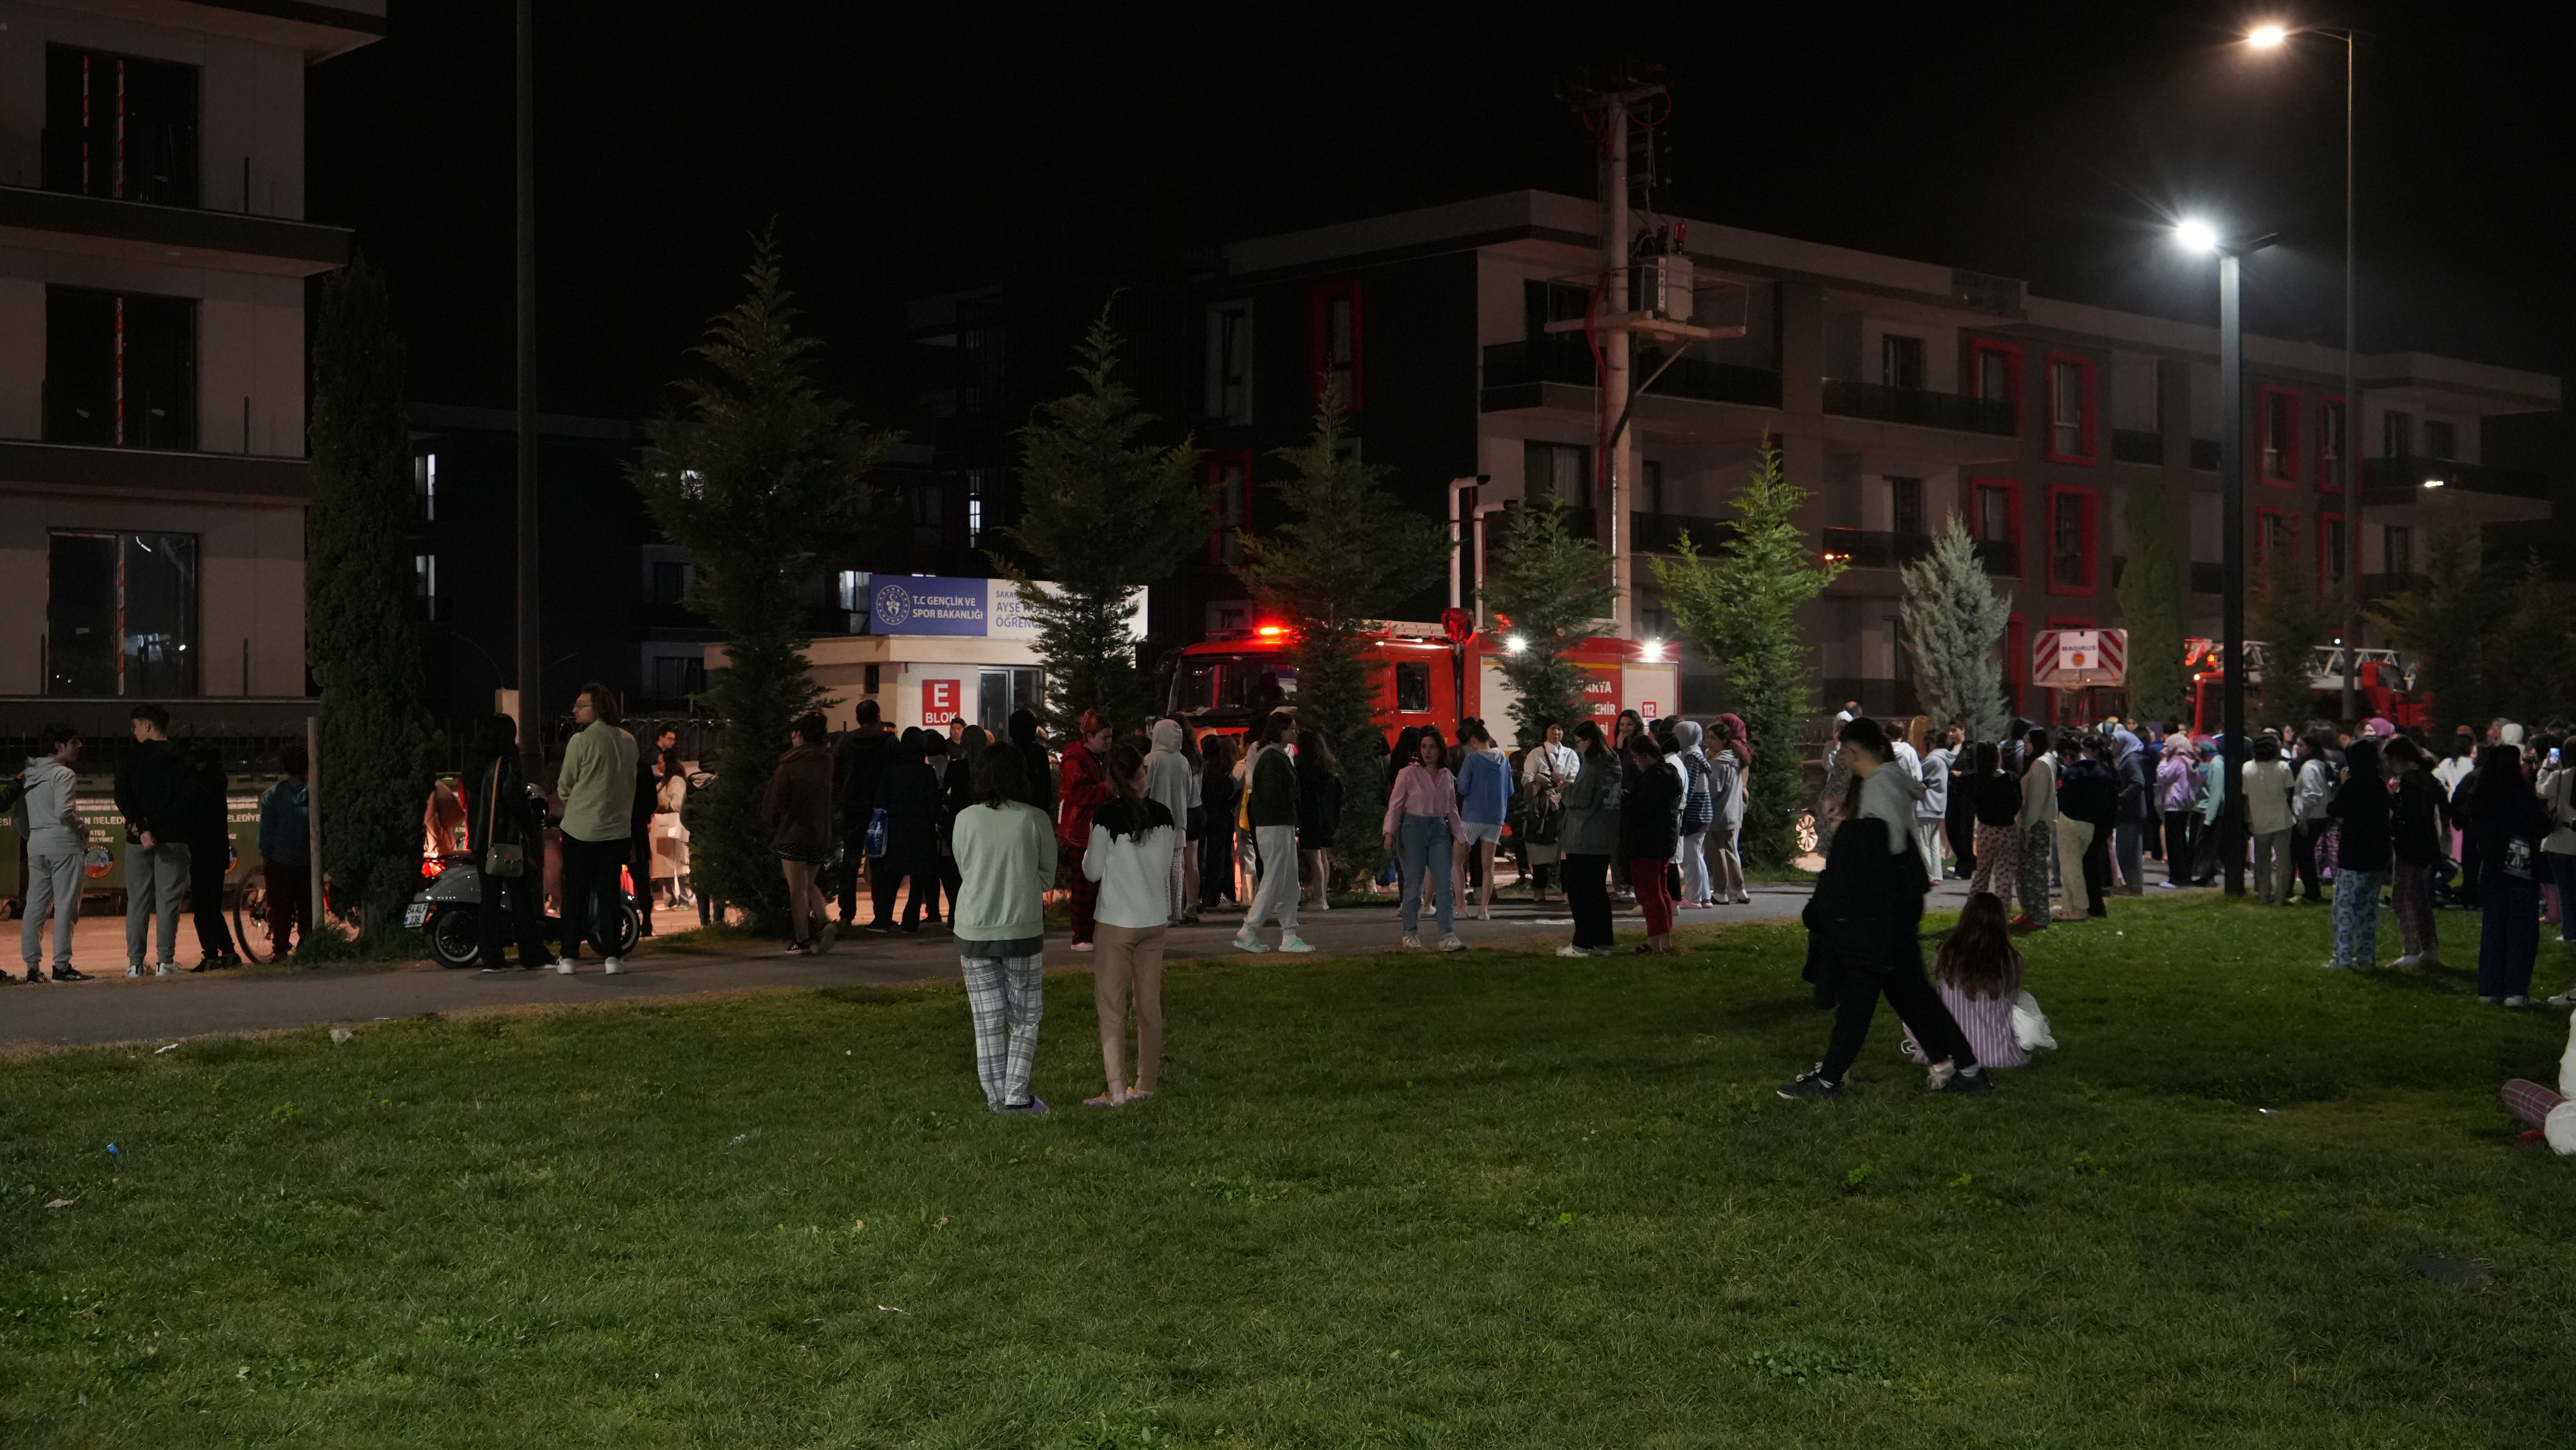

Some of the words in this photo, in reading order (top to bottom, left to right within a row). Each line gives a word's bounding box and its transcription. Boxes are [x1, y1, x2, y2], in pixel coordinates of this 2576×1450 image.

[927, 595, 963, 608] GENÇLİK
[965, 597, 976, 606] VE
[912, 609, 935, 618] SPOR
[937, 609, 983, 619] BAKANLIĞI
[997, 602, 1020, 614] AYŞE
[934, 683, 949, 707] E
[1644, 704, 1655, 717] 112
[925, 712, 958, 724] BLOK
